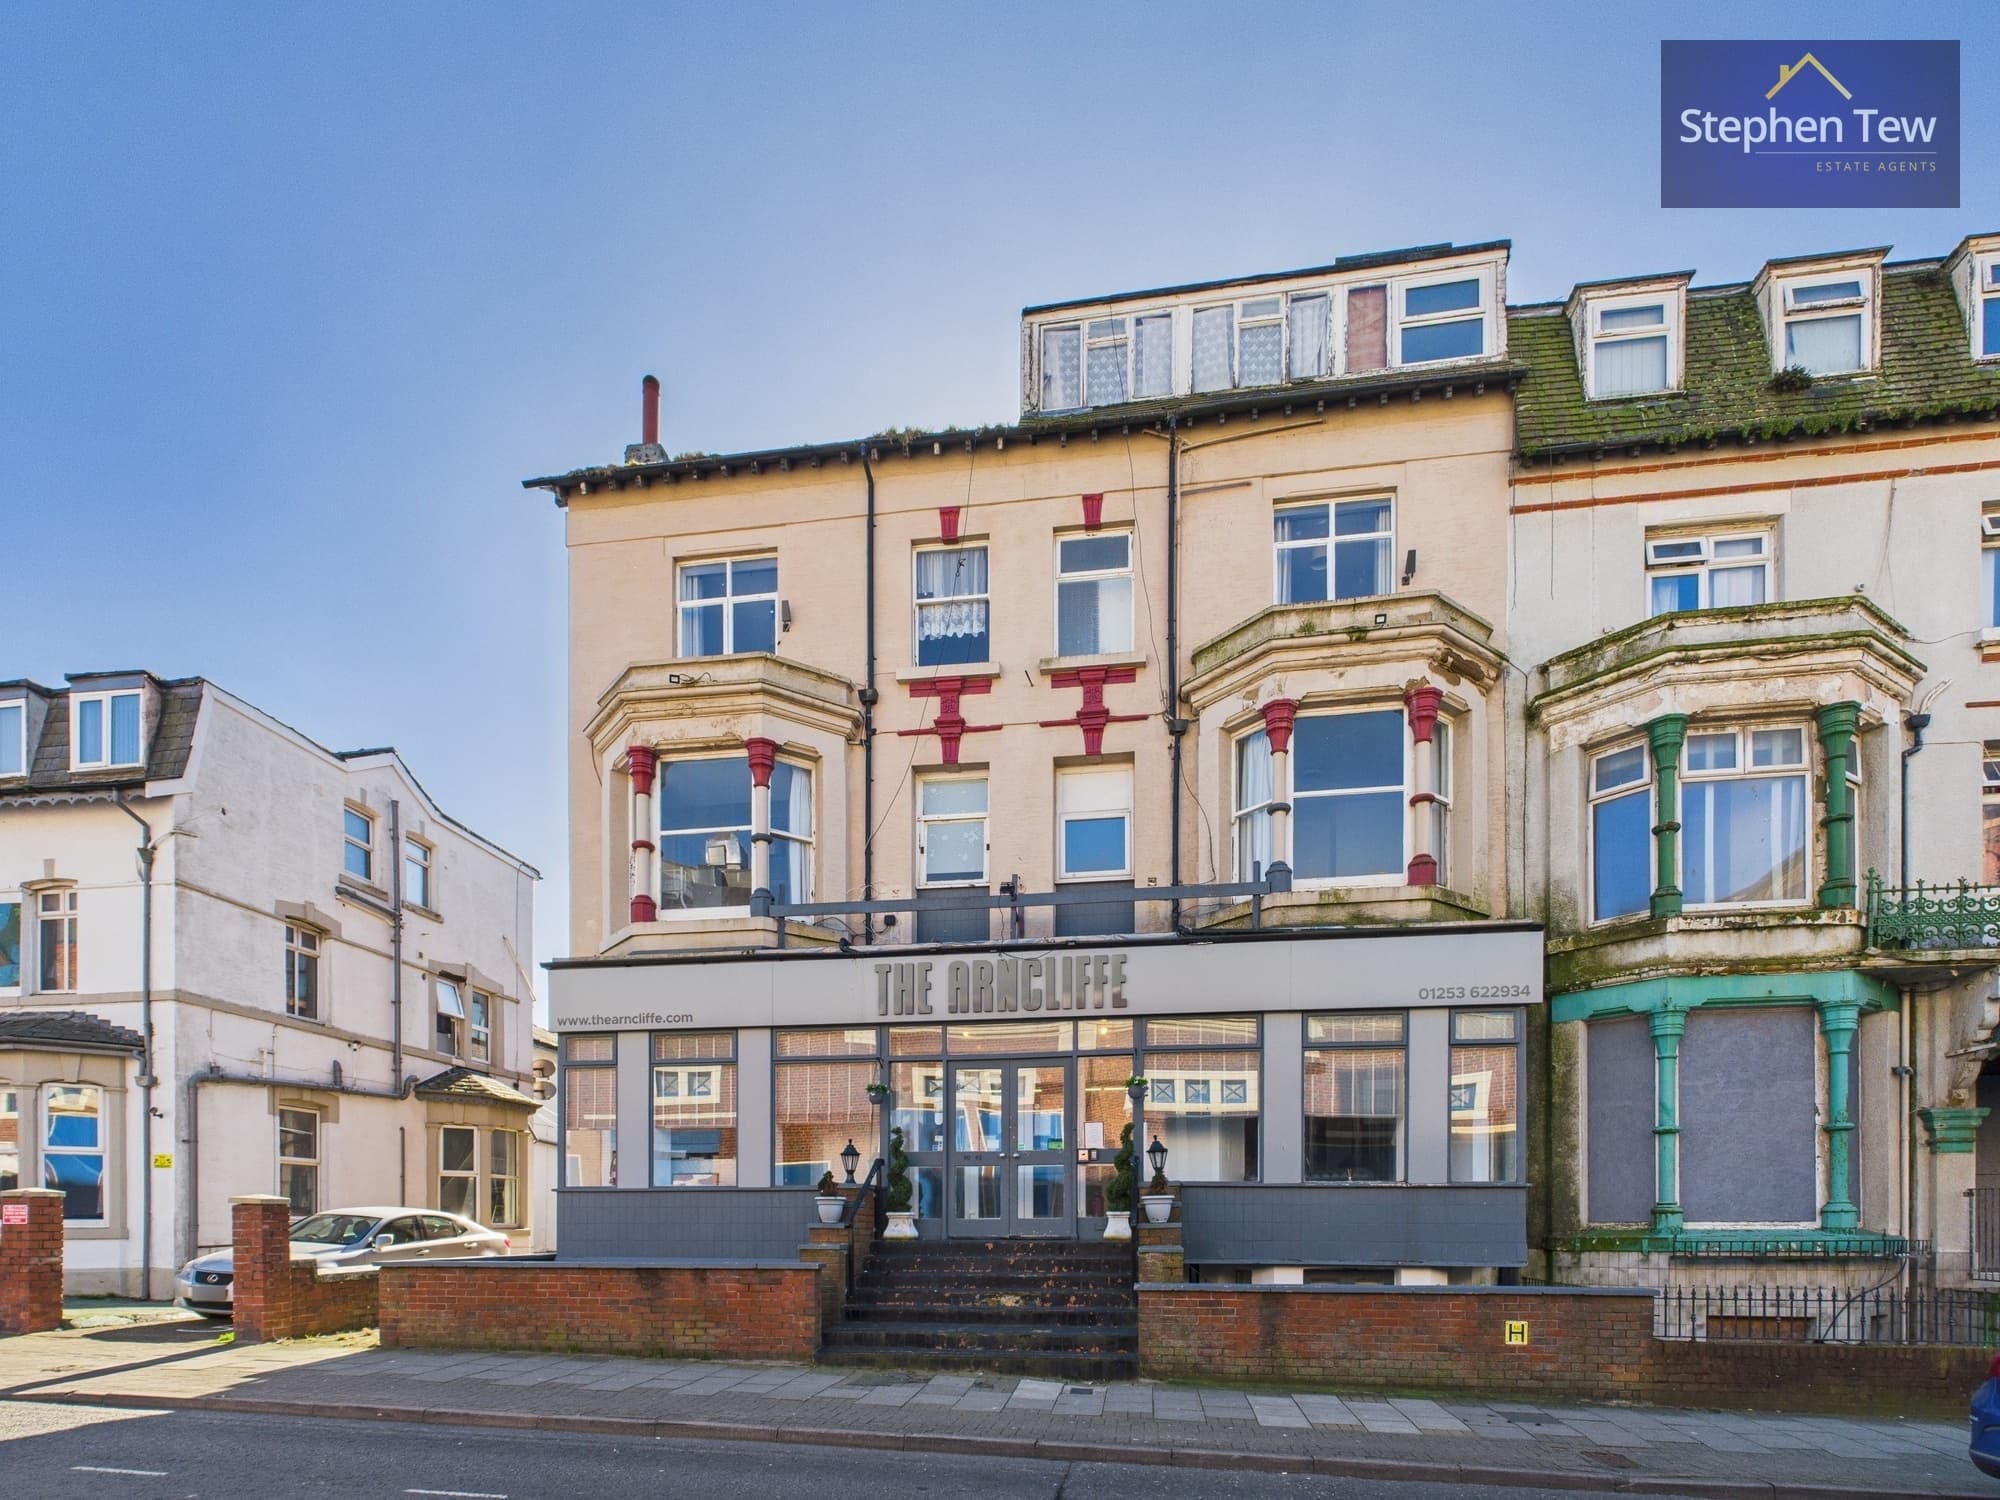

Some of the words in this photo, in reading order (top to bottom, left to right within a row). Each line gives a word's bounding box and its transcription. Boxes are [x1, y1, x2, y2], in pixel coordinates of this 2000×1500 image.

[875, 962, 932, 1016] THE
[948, 953, 1128, 1014] ARNCLIFFE
[1418, 987, 1466, 1000] 01253
[1470, 985, 1531, 998] 622934
[557, 1012, 694, 1026] www.thearncliffe.com
[1509, 1323, 1525, 1342] H
